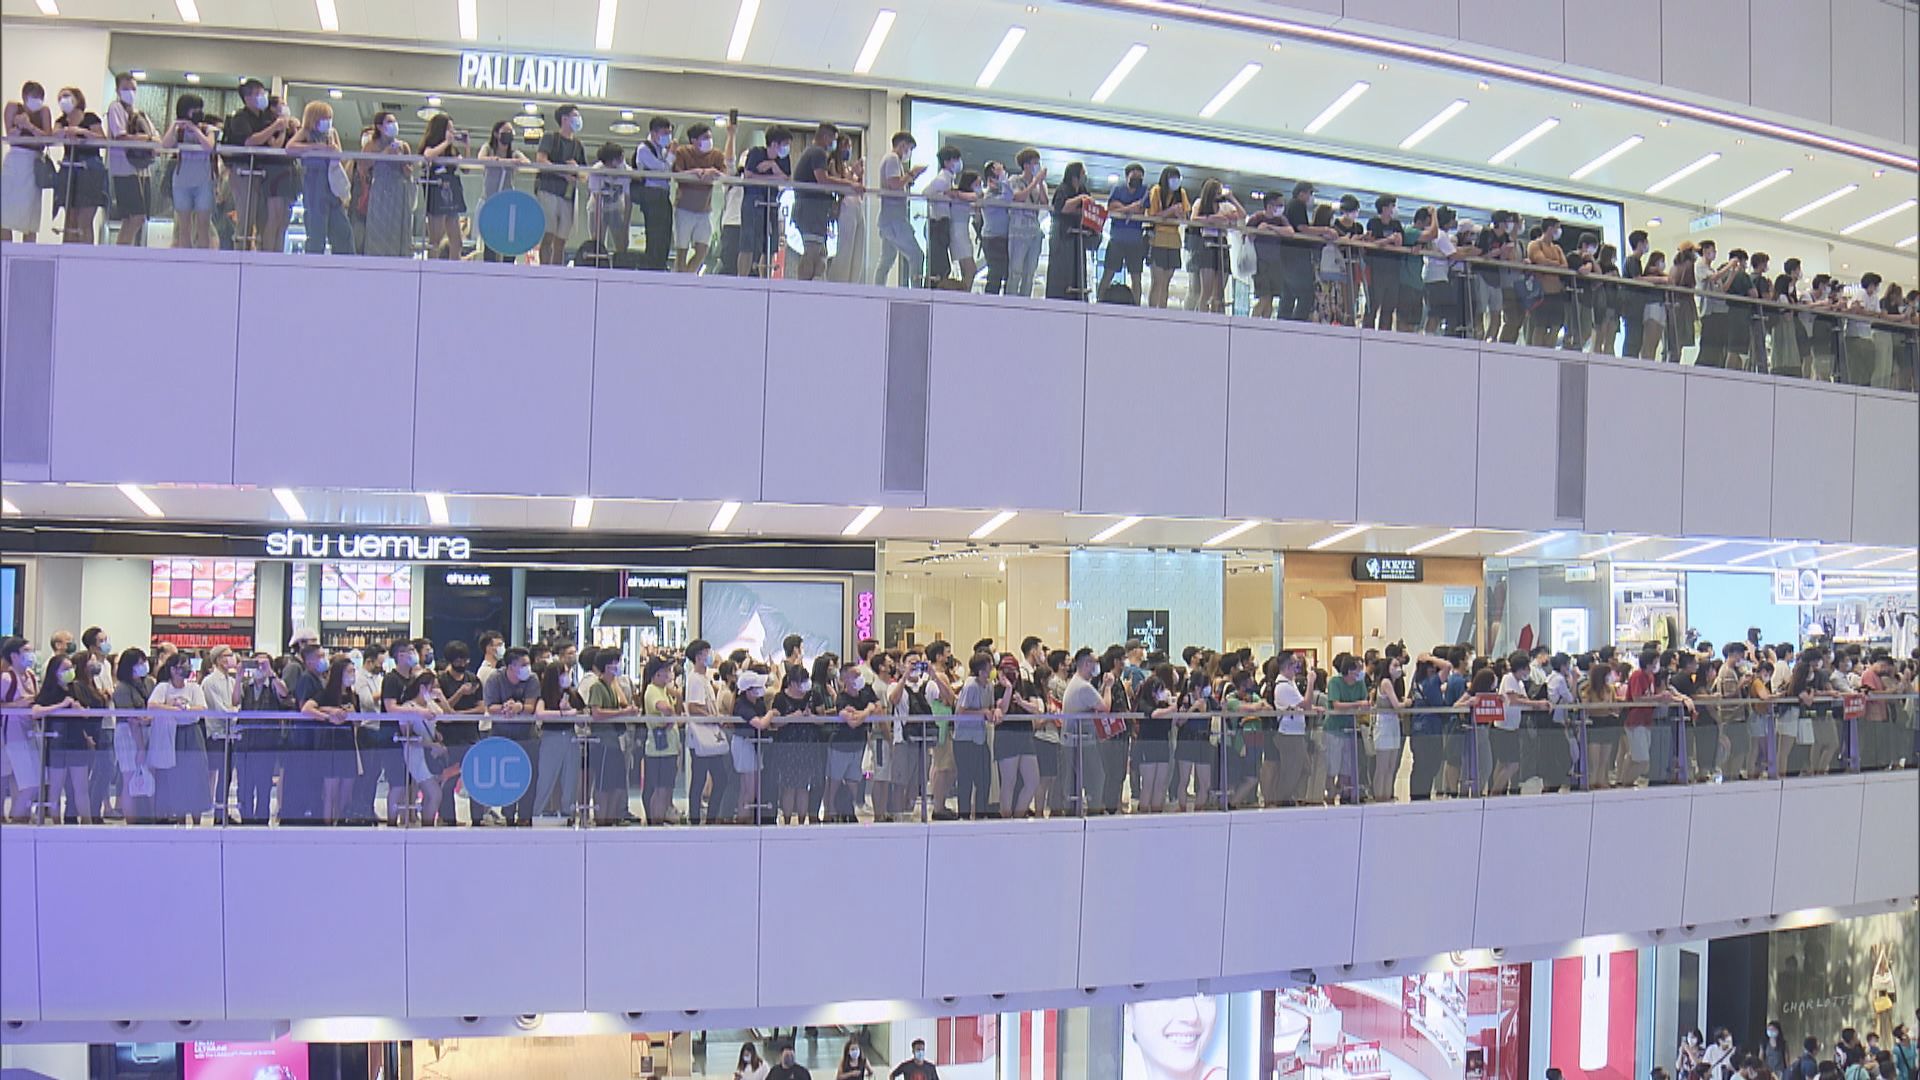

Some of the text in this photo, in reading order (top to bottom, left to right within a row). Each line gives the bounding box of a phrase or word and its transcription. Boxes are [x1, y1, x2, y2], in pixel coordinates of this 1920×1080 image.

[460, 53, 608, 99] PALLADIUM
[266, 529, 471, 560] shu uemura
[474, 756, 521, 789] UC
